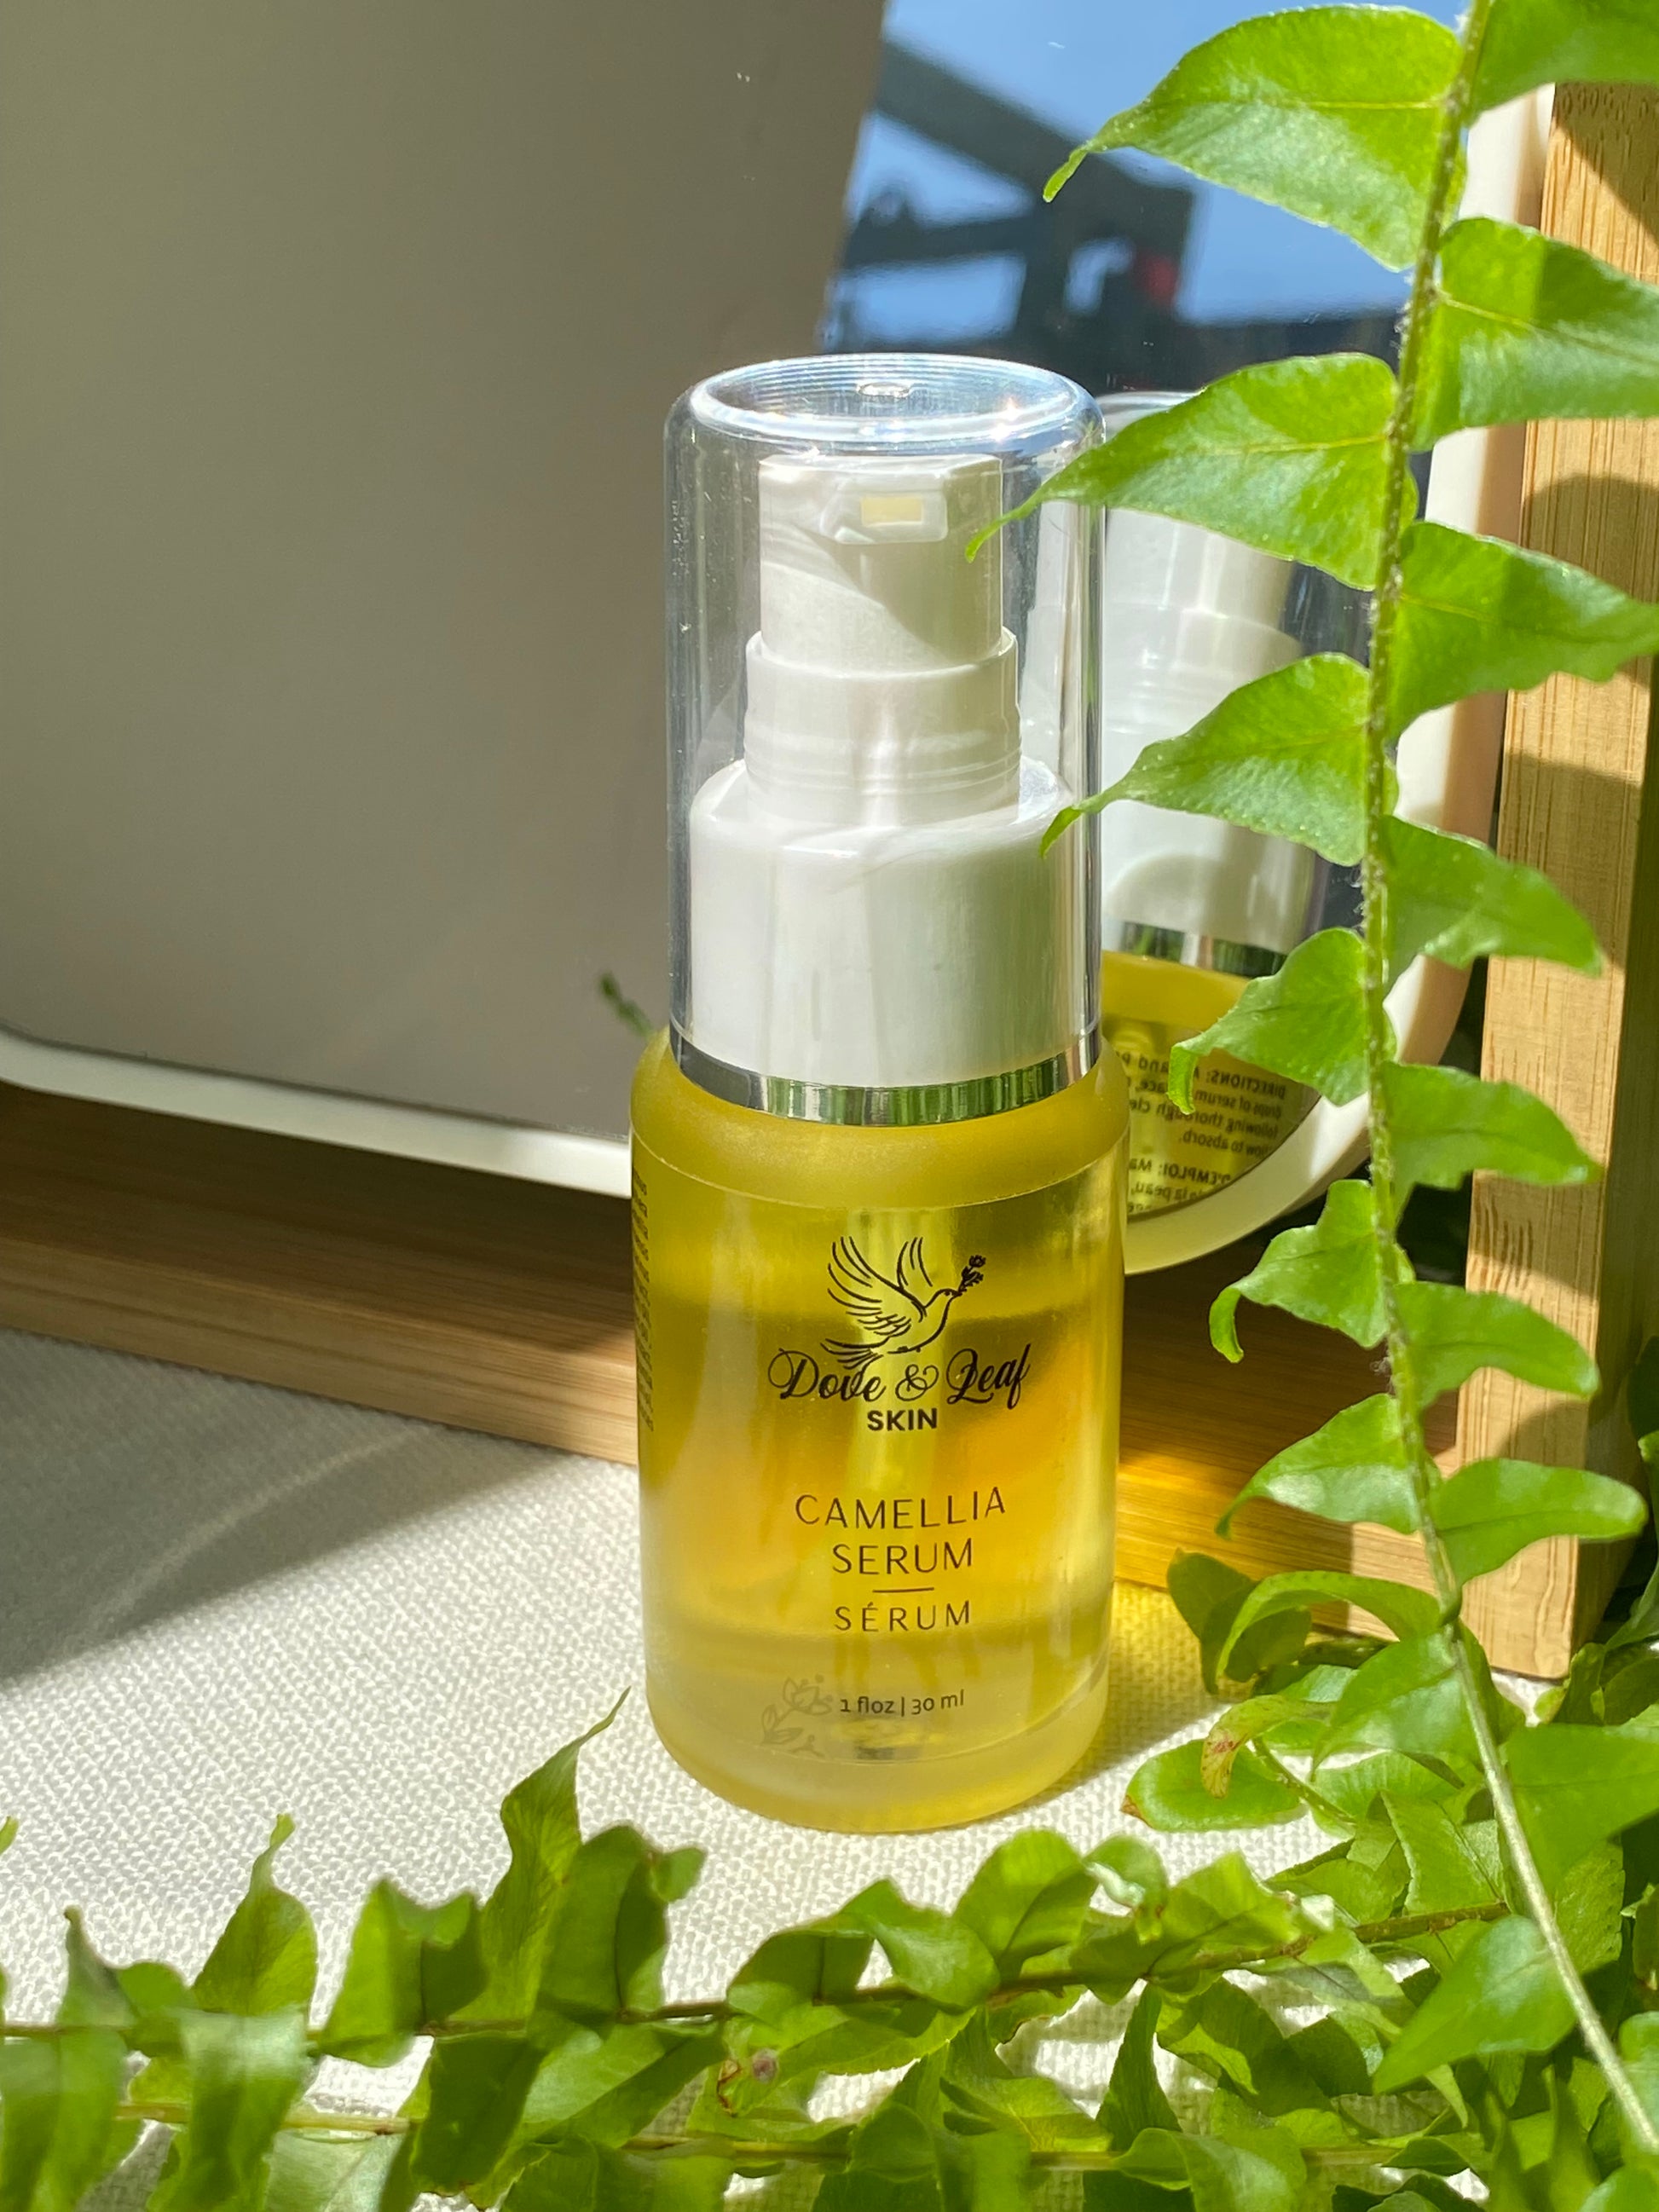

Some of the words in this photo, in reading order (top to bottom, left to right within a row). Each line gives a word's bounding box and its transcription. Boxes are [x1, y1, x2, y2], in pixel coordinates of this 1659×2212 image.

[768, 1348, 887, 1402] Dove
[895, 1364, 939, 1402] &
[946, 1343, 1031, 1410] Leaf
[867, 1408, 938, 1431] SKIN
[795, 1486, 1005, 1530] CAMELLIA
[832, 1537, 973, 1575] SERUM
[835, 1600, 970, 1632] SÉRUM
[840, 1699, 851, 1712] 1
[911, 1697, 934, 1715] 30
[940, 1689, 964, 1710] ml
